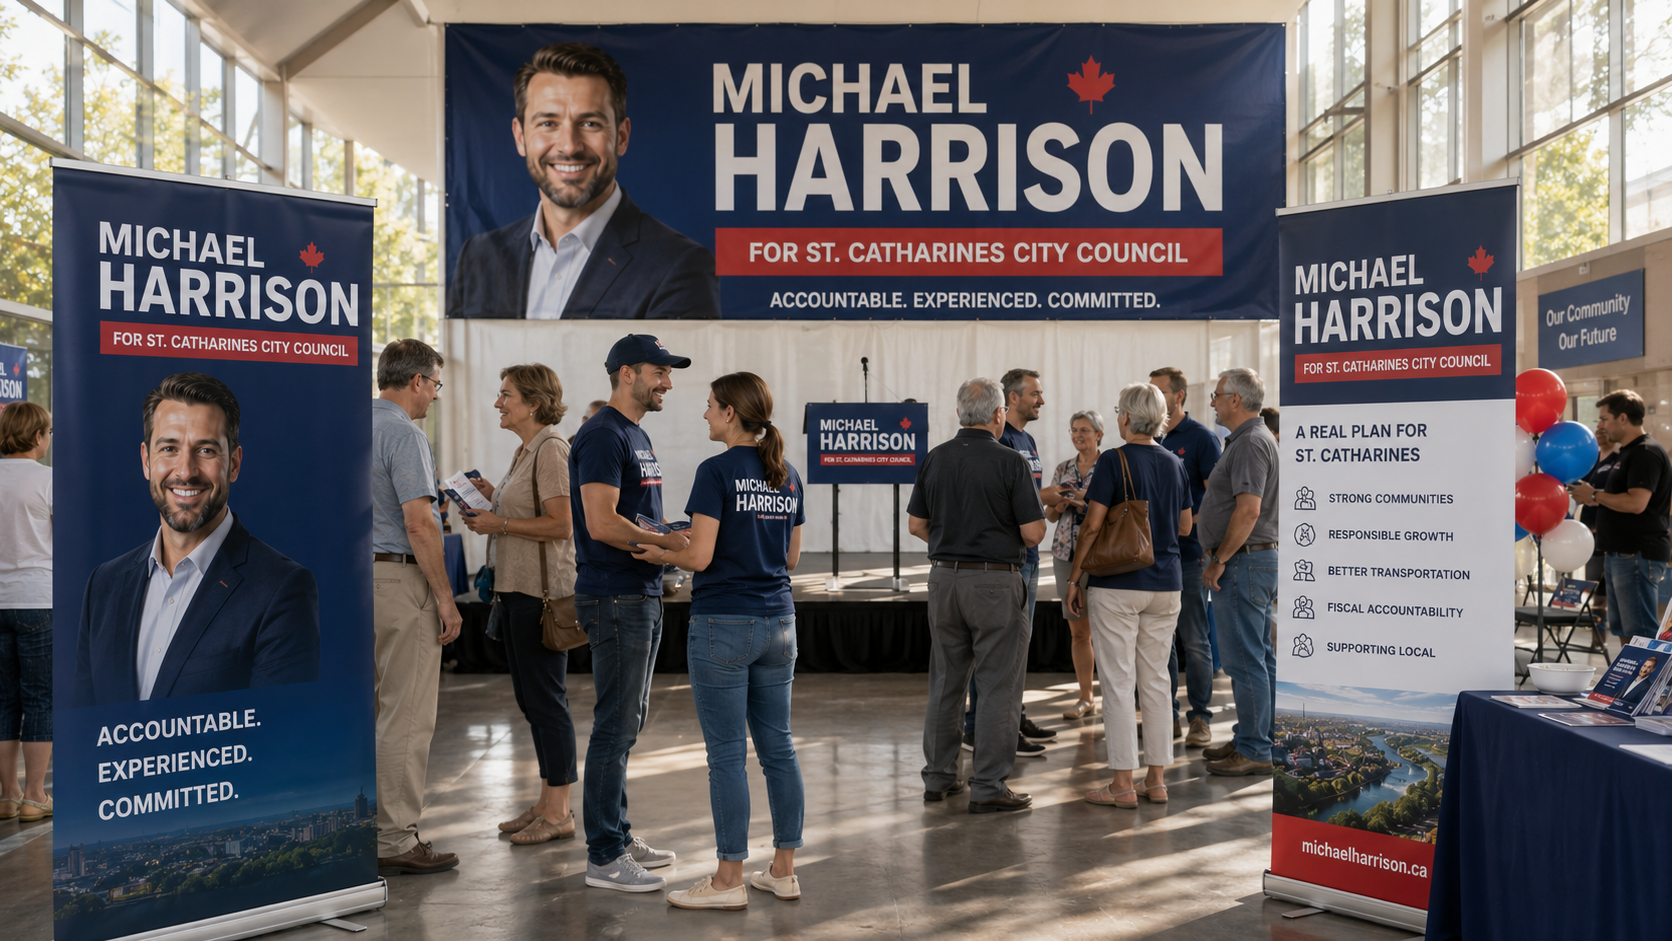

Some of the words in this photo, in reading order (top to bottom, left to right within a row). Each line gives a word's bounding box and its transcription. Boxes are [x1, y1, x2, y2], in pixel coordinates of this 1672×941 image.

[713, 63, 987, 114] MICHAEL
[715, 122, 1222, 212] HARRISON
[99, 221, 264, 268] MICHAEL
[750, 242, 798, 262] FOR
[807, 242, 839, 262] ST.
[849, 242, 1004, 262] CATHARINES
[1014, 243, 1069, 262] CITY
[1077, 243, 1188, 262] COUNCIL
[1295, 254, 1424, 295] MICHAEL
[100, 261, 359, 327] HARRISON
[770, 292, 907, 308] ACCOUNTABLE.
[914, 292, 1041, 308] EXPERIENCED.
[1048, 292, 1160, 308] COMMITTED.
[1295, 287, 1502, 344] HARRISON
[1546, 310, 1565, 327] Our
[1567, 294, 1630, 322] Community
[114, 332, 142, 346] FOR
[147, 334, 166, 347] ST.
[172, 335, 257, 352] CATHARINES
[262, 341, 290, 353] CITY
[294, 342, 348, 356] COUNCIL
[1559, 333, 1578, 350] Our
[1581, 327, 1616, 346] Future
[1304, 363, 1323, 374] FOR
[1326, 362, 1339, 373] ST.
[1343, 358, 1408, 372] CATHARINES
[1412, 357, 1436, 369] CITY
[1440, 355, 1491, 368] COUNCIL
[0, 379, 22, 399] ISON
[821, 419, 878, 430] MICHAEL
[1296, 426, 1305, 438] A
[1311, 425, 1347, 438] REAL
[1352, 424, 1391, 438] PLAN
[1397, 424, 1426, 437] FOR
[821, 433, 915, 450] HARRISON
[1296, 449, 1315, 462] ST.
[1321, 448, 1420, 462] CATHARINES
[736, 494, 798, 515] HARRISON
[1329, 494, 1371, 503] STRONG
[1376, 494, 1453, 504] COMMUNITIES
[1329, 530, 1400, 540] RESPONSIBLE
[1404, 531, 1453, 541] GROWTH
[1329, 566, 1367, 576] BETTER
[1371, 568, 1469, 580] TRANSPORTATION
[1328, 603, 1364, 613] FISCAL
[1367, 605, 1463, 618] ACCOUNTABILITY
[1327, 642, 1395, 655] SUPPORTING
[1400, 647, 1435, 657] LOCAL
[97, 709, 261, 747] ACCOUNTABLE.
[98, 745, 252, 783] EXPERIENCED.
[98, 781, 239, 821] COMMITTED.
[1302, 840, 1427, 878] michaelharrison.ca
